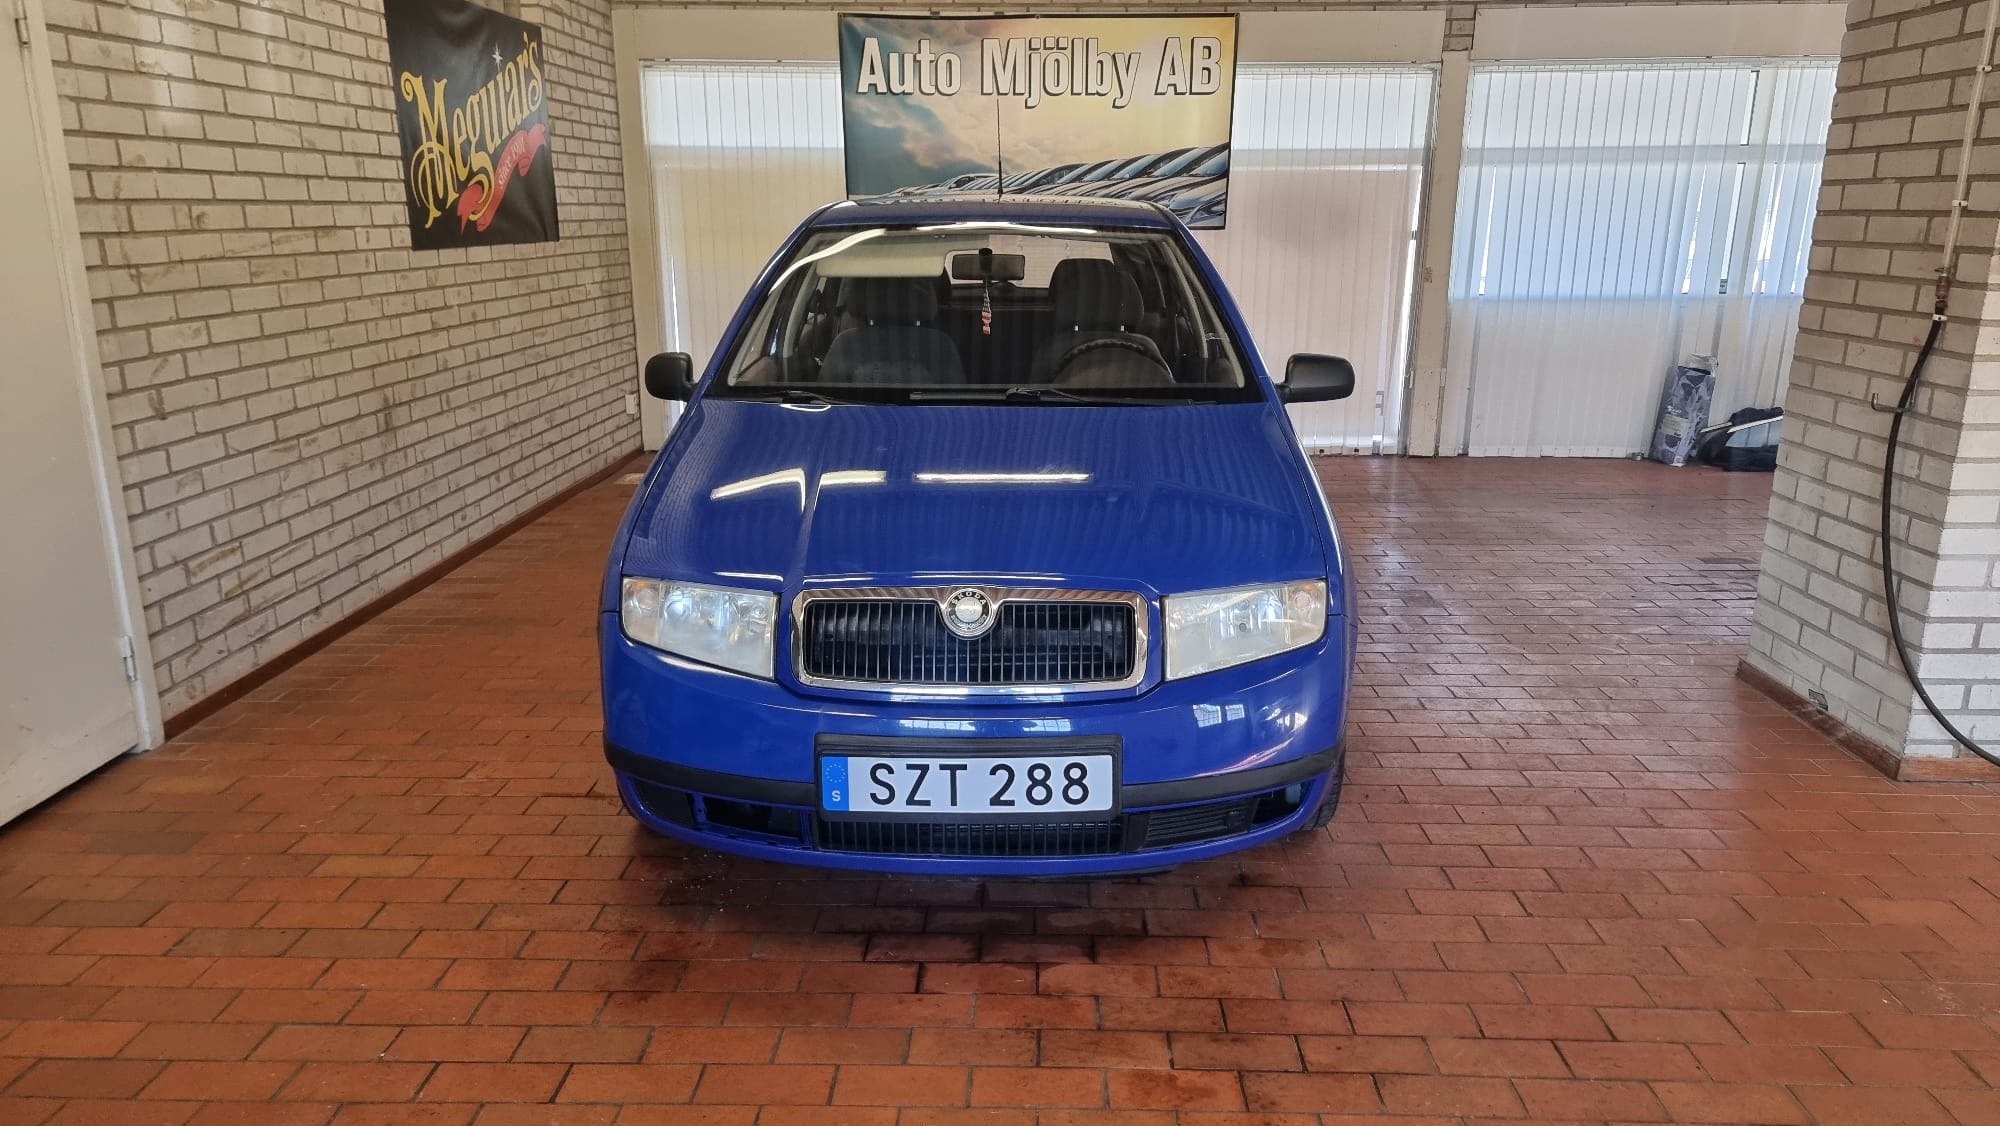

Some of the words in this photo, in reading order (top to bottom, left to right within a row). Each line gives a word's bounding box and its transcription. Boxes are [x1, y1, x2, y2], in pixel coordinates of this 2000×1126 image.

[856, 36, 962, 96] Auto
[980, 36, 1141, 109] Mjölby
[1154, 36, 1223, 96] AB
[401, 31, 543, 229] Meguiar's
[831, 789, 841, 802] S
[869, 762, 968, 807] SZT
[989, 762, 1089, 806] 288
